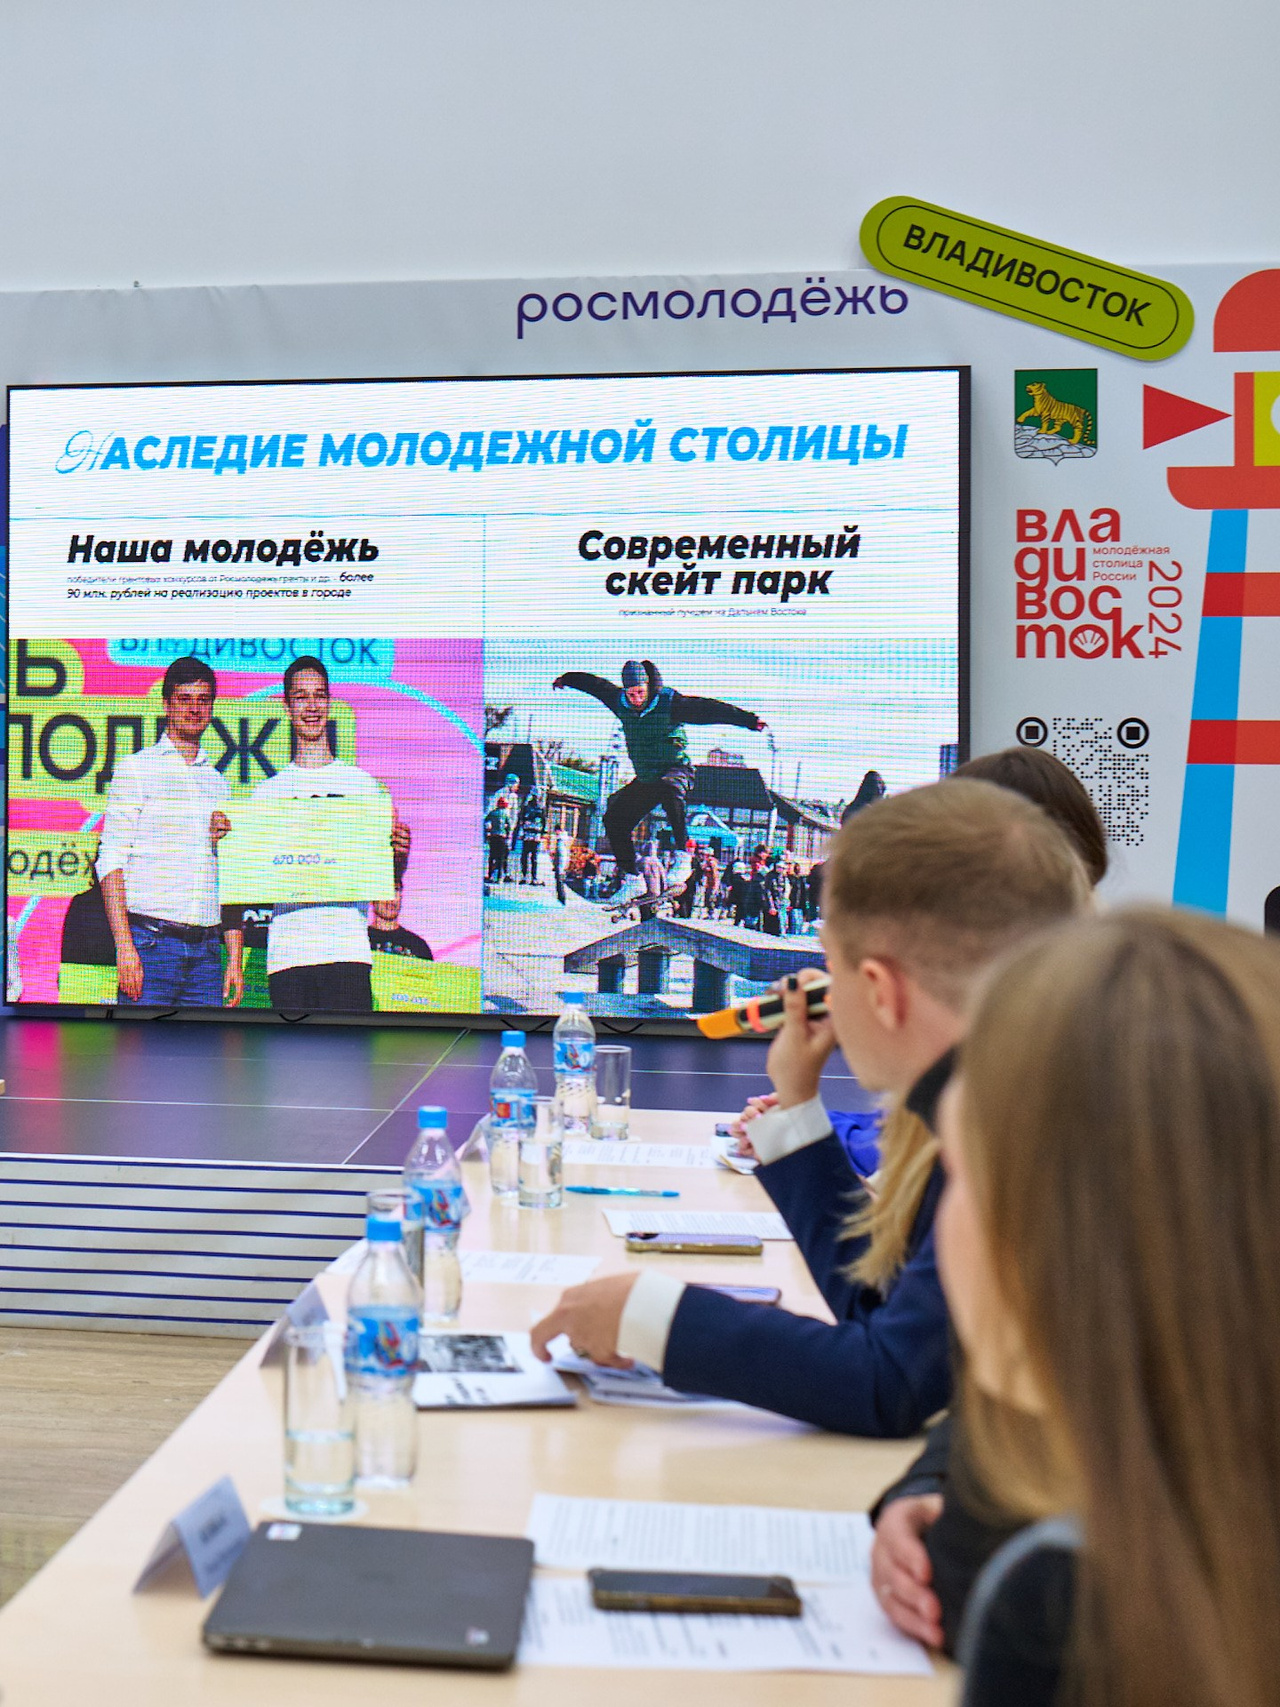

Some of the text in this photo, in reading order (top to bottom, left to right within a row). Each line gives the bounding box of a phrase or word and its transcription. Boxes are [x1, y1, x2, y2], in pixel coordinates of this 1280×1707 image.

[902, 223, 1152, 327] ВЛАДИВОСТОК
[516, 276, 909, 340] росмолодёжь
[55, 418, 909, 475] НАСЛЕДИЕ МОЛОДЕЖНОЙ СТОЛИЦЫ
[66, 529, 380, 567] Наша молодёжь
[578, 525, 862, 568] Современный
[1092, 545, 1171, 556] молодёжная
[1092, 559, 1144, 569] столица
[109, 587, 152, 601] рублей
[153, 589, 169, 599] на
[170, 588, 243, 601] реализацию
[246, 588, 302, 600] проектов
[310, 588, 352, 599] городе
[338, 570, 375, 583] более
[605, 562, 834, 603] скейт парк
[1092, 571, 1137, 582] России
[1147, 559, 1183, 660] 2024
